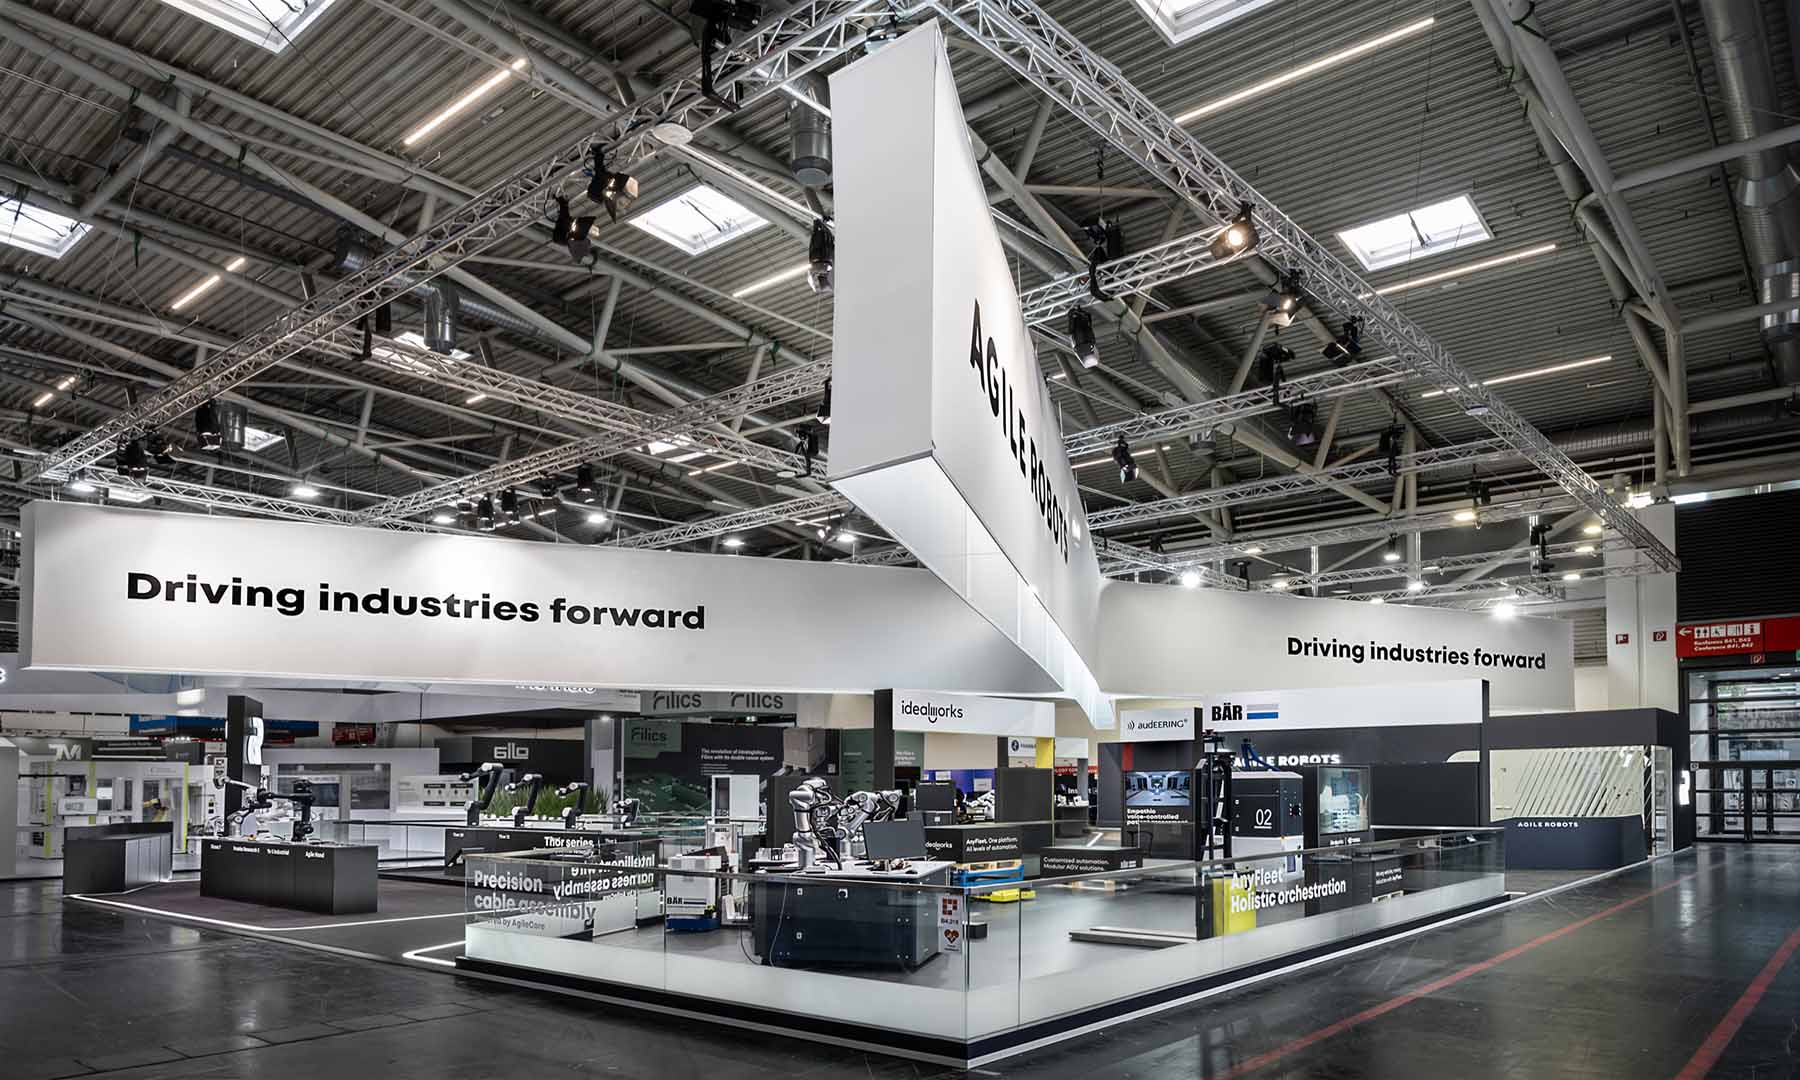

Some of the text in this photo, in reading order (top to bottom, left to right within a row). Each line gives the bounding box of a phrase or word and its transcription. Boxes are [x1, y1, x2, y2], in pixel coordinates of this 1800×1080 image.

[970, 297, 1068, 564] AGILE ROBOTS
[127, 571, 705, 630] Driving industries forward
[1287, 637, 1546, 669] Driving industries forward
[1212, 702, 1242, 721] BÄR
[631, 727, 667, 743] Filics
[1278, 754, 1340, 766] ROBOTS
[1255, 809, 1272, 825] 02
[544, 836, 564, 847] Thor
[474, 870, 543, 893] Precision
[1232, 868, 1284, 891] AnyFleet
[1231, 877, 1347, 913] Holistic orchestration
[474, 893, 514, 913] cable
[518, 900, 596, 927] assembly
